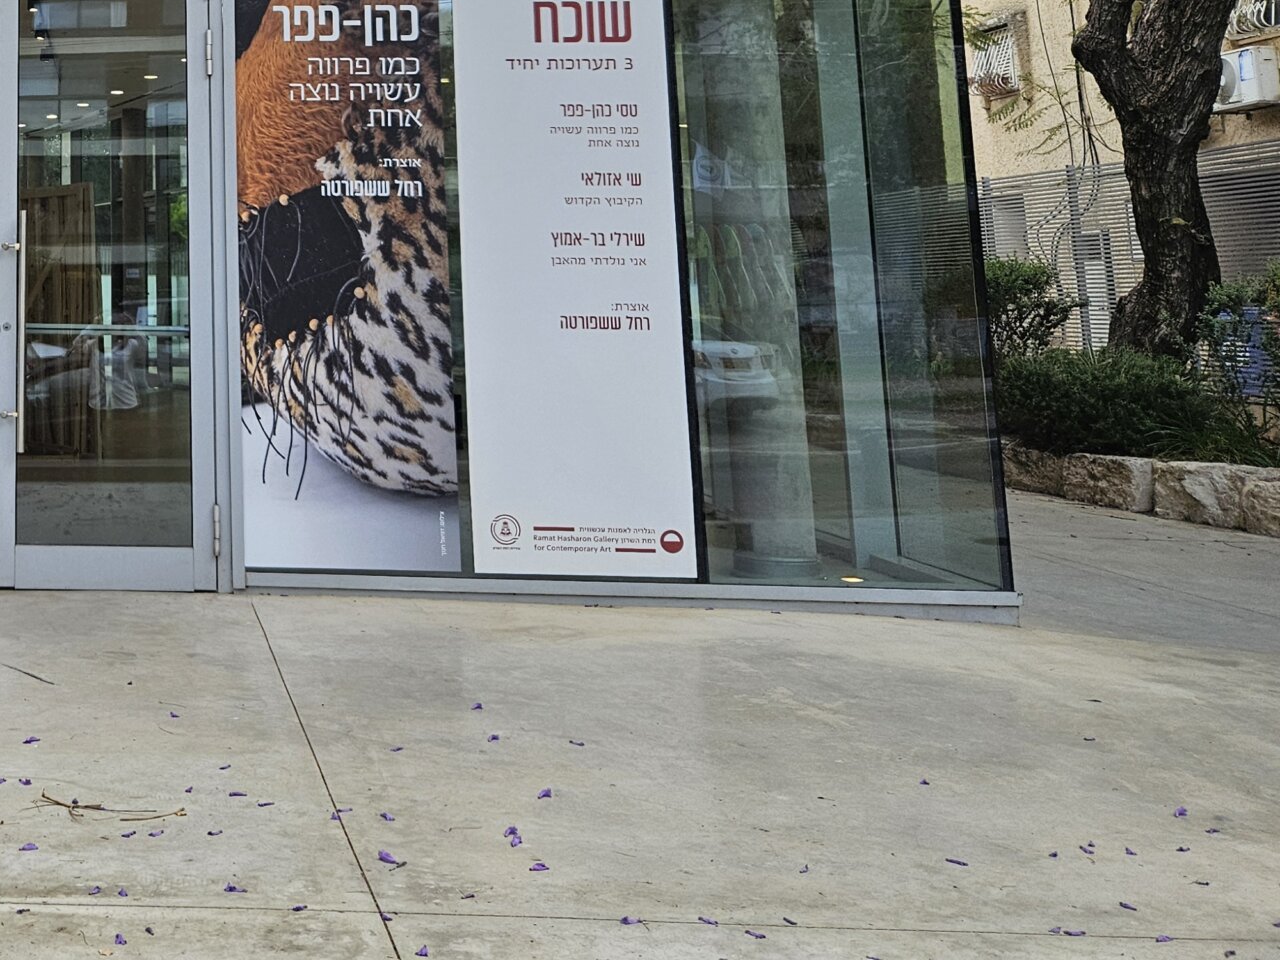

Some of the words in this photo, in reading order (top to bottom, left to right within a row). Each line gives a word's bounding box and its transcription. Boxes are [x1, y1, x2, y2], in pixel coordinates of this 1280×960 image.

[272, 3, 420, 47] כהן-פפר
[532, 0, 632, 43] שוכח
[307, 55, 371, 76] פרווה
[378, 56, 421, 75] כמו
[505, 58, 540, 70] יחיד
[546, 57, 617, 71] תערוכות
[624, 57, 634, 70] 3
[288, 82, 341, 102] נוצה
[349, 82, 421, 102] עשויה
[559, 103, 612, 119] כהן-פפר
[616, 103, 639, 118] טסי
[366, 108, 423, 128] אחת
[549, 126, 583, 135] עשויה
[586, 126, 616, 135] פרווה
[620, 126, 639, 135] כמו
[587, 139, 613, 148] אחת
[616, 139, 640, 148] נוצה
[378, 157, 422, 168] אוצרת:
[581, 171, 622, 187] אזולאי
[626, 172, 642, 187] שי
[320, 180, 390, 198] ששפורטה
[394, 178, 423, 198] רחל
[564, 196, 601, 207] הקדוש
[604, 197, 643, 207] הקיבוץ
[550, 231, 606, 248] בר-אמוץ
[610, 231, 646, 247] שירלי
[550, 256, 587, 267] מהאבן
[590, 255, 626, 266] נולדתי
[630, 257, 647, 266] אני
[611, 302, 650, 312] אוצרת:
[560, 315, 622, 330] ששפורטה
[625, 315, 651, 331] רחל
[607, 526, 632, 534] לאמנות
[633, 527, 656, 535] הגלריה
[533, 534, 556, 542] Ramat
[557, 534, 592, 543] Hasharon
[593, 535, 619, 545] Gallery
[534, 543, 545, 551] for
[546, 544, 599, 554] Contemporary
[599, 545, 612, 553] Art
